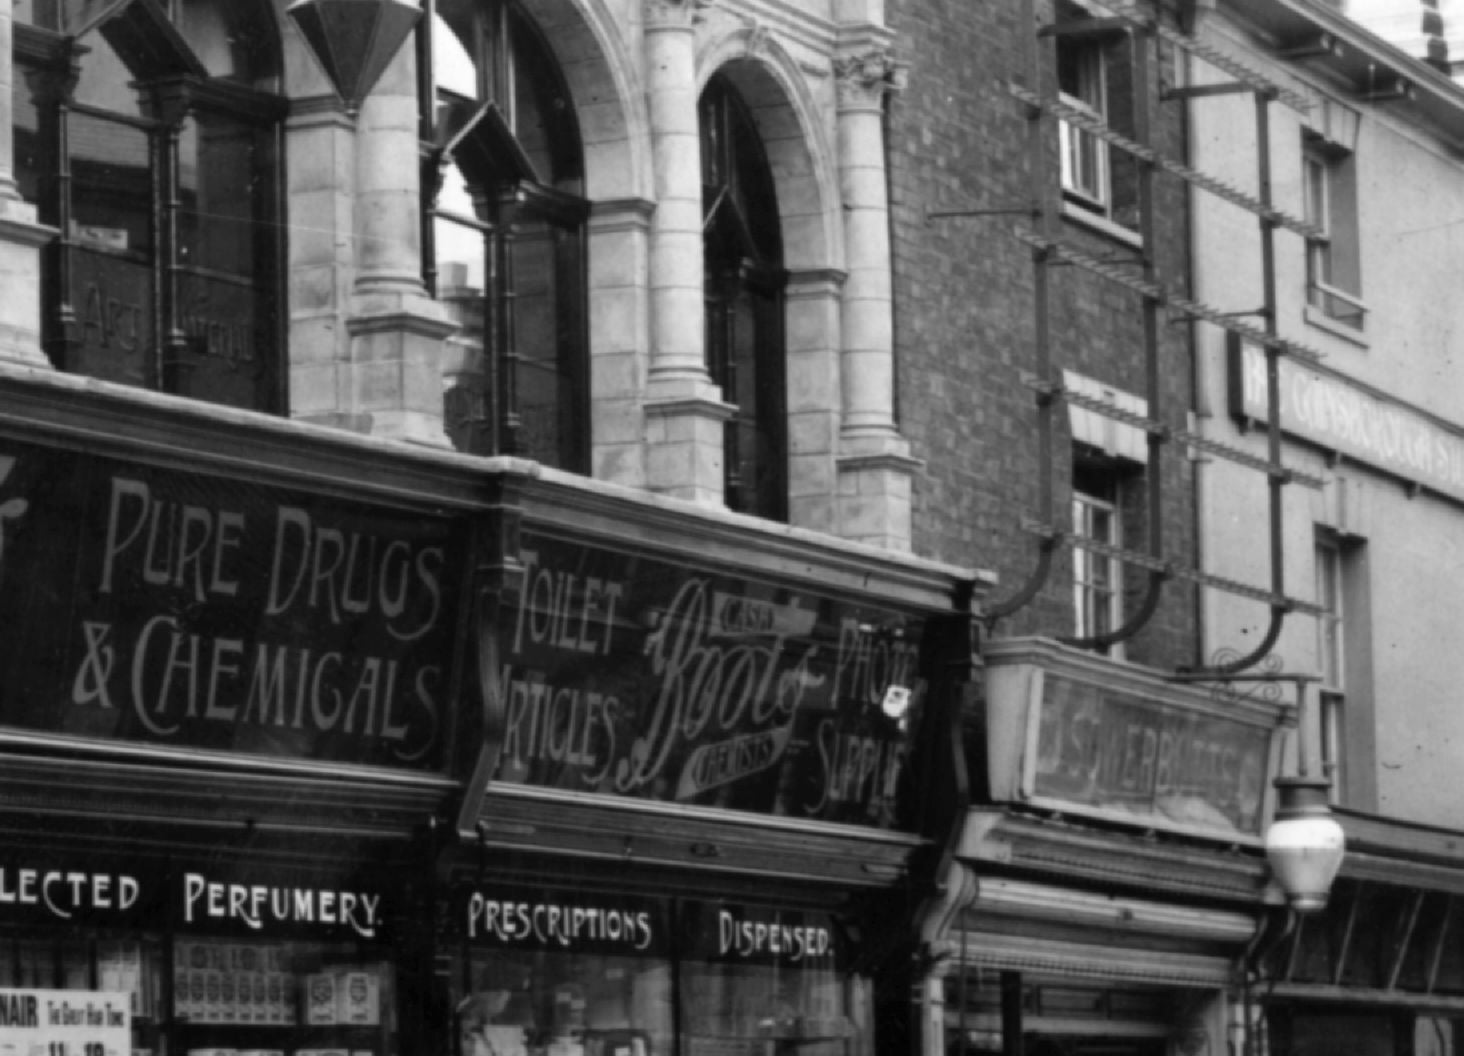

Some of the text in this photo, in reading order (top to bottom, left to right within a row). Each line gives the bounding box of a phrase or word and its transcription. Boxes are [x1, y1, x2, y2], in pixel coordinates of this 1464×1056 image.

[99, 476, 445, 641] PURE DRUGS
[512, 550, 624, 656] TOILET
[72, 615, 442, 761] & CHEMICALS
[616, 577, 817, 792] Boots
[468, 891, 651, 949] PRESCRIPTIONS
